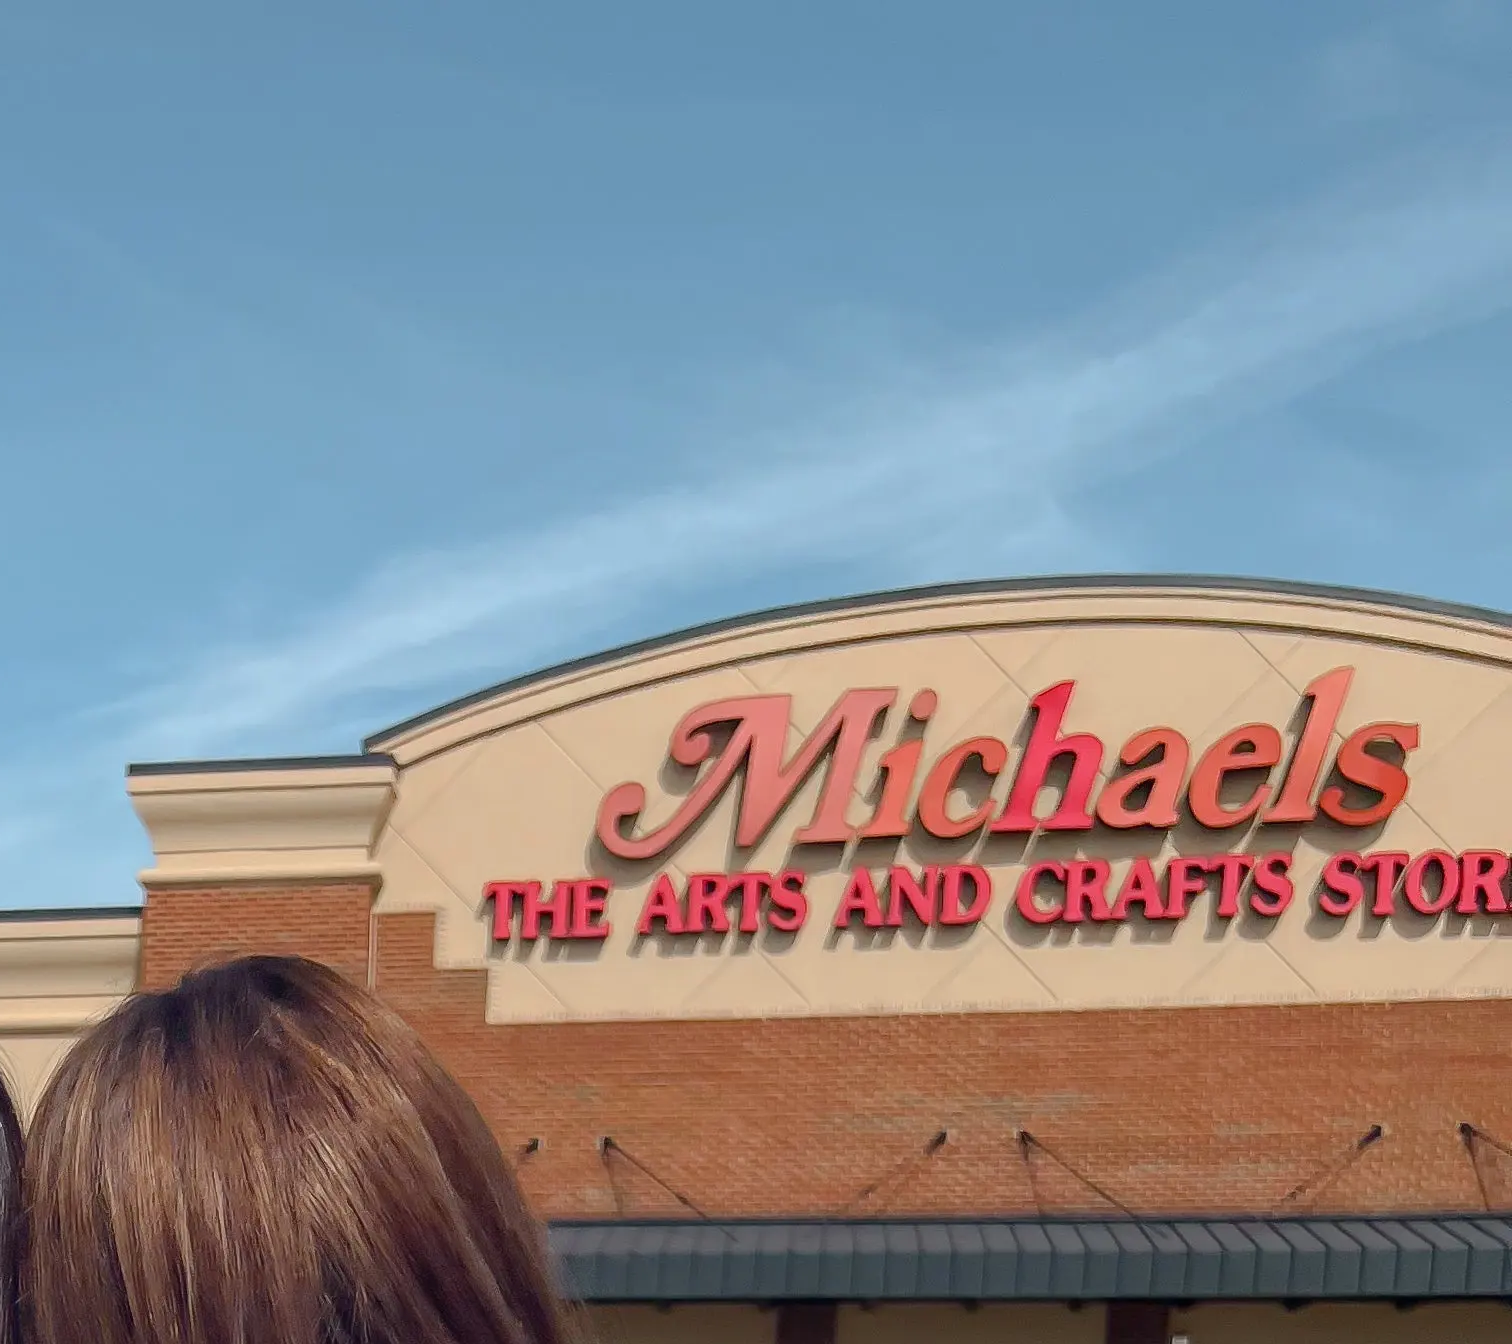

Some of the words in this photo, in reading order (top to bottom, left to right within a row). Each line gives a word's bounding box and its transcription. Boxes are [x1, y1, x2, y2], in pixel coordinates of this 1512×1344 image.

[596, 664, 1419, 858] Michaels
[484, 878, 609, 942] THE
[638, 868, 806, 935] ARTS
[834, 862, 992, 928] AND
[1014, 850, 1293, 923] CRAFTS
[1319, 849, 1512, 916] STOR
